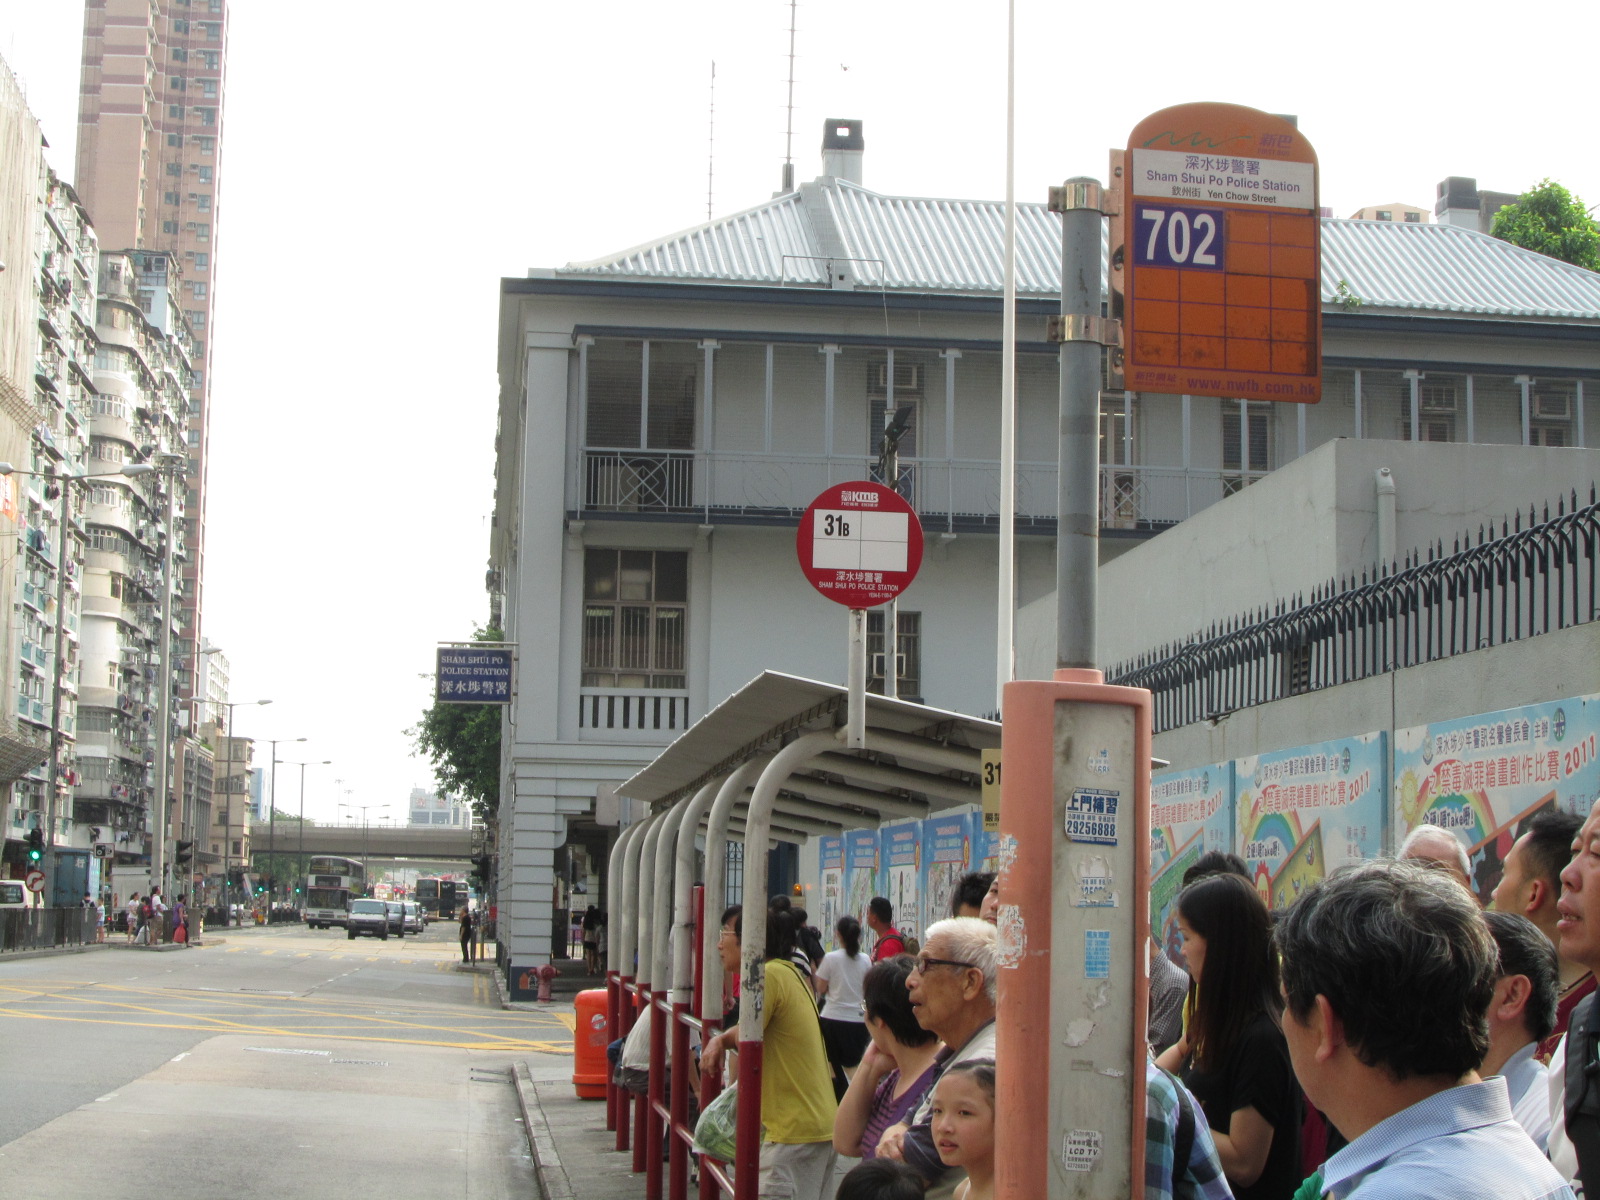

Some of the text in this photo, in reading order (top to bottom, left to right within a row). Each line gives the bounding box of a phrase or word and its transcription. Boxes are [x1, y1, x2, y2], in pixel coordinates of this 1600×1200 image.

[1259, 133, 1293, 149] 新巴
[1185, 155, 1260, 176] 深水埗警署
[1146, 170, 1300, 193] Sham Shui Po Police Station
[1171, 185, 1201, 198] 欽州街
[1207, 189, 1277, 204] Yen Chow Street
[1141, 208, 1216, 266] 702
[1187, 376, 1316, 397] www.nwfb.com.hk
[852, 491, 879, 503] KMB
[824, 513, 850, 537] 31B
[836, 571, 883, 583] 深水埗警署
[818, 581, 833, 589] SHAM
[848, 582, 856, 590] PO
[857, 583, 876, 591] POLICE
[877, 584, 899, 592] STATION
[441, 655, 503, 665] SHAM SHUI PO
[441, 666, 509, 676] POLICE STATION
[441, 680, 508, 695] 深水埗警署
[1564, 734, 1596, 776] 2011
[1348, 770, 1369, 802] 2011
[1067, 792, 1118, 815] 上門補習
[1207, 789, 1222, 817] 2011
[1067, 820, 1116, 837] 29256888
[1088, 1148, 1098, 1156] TV
